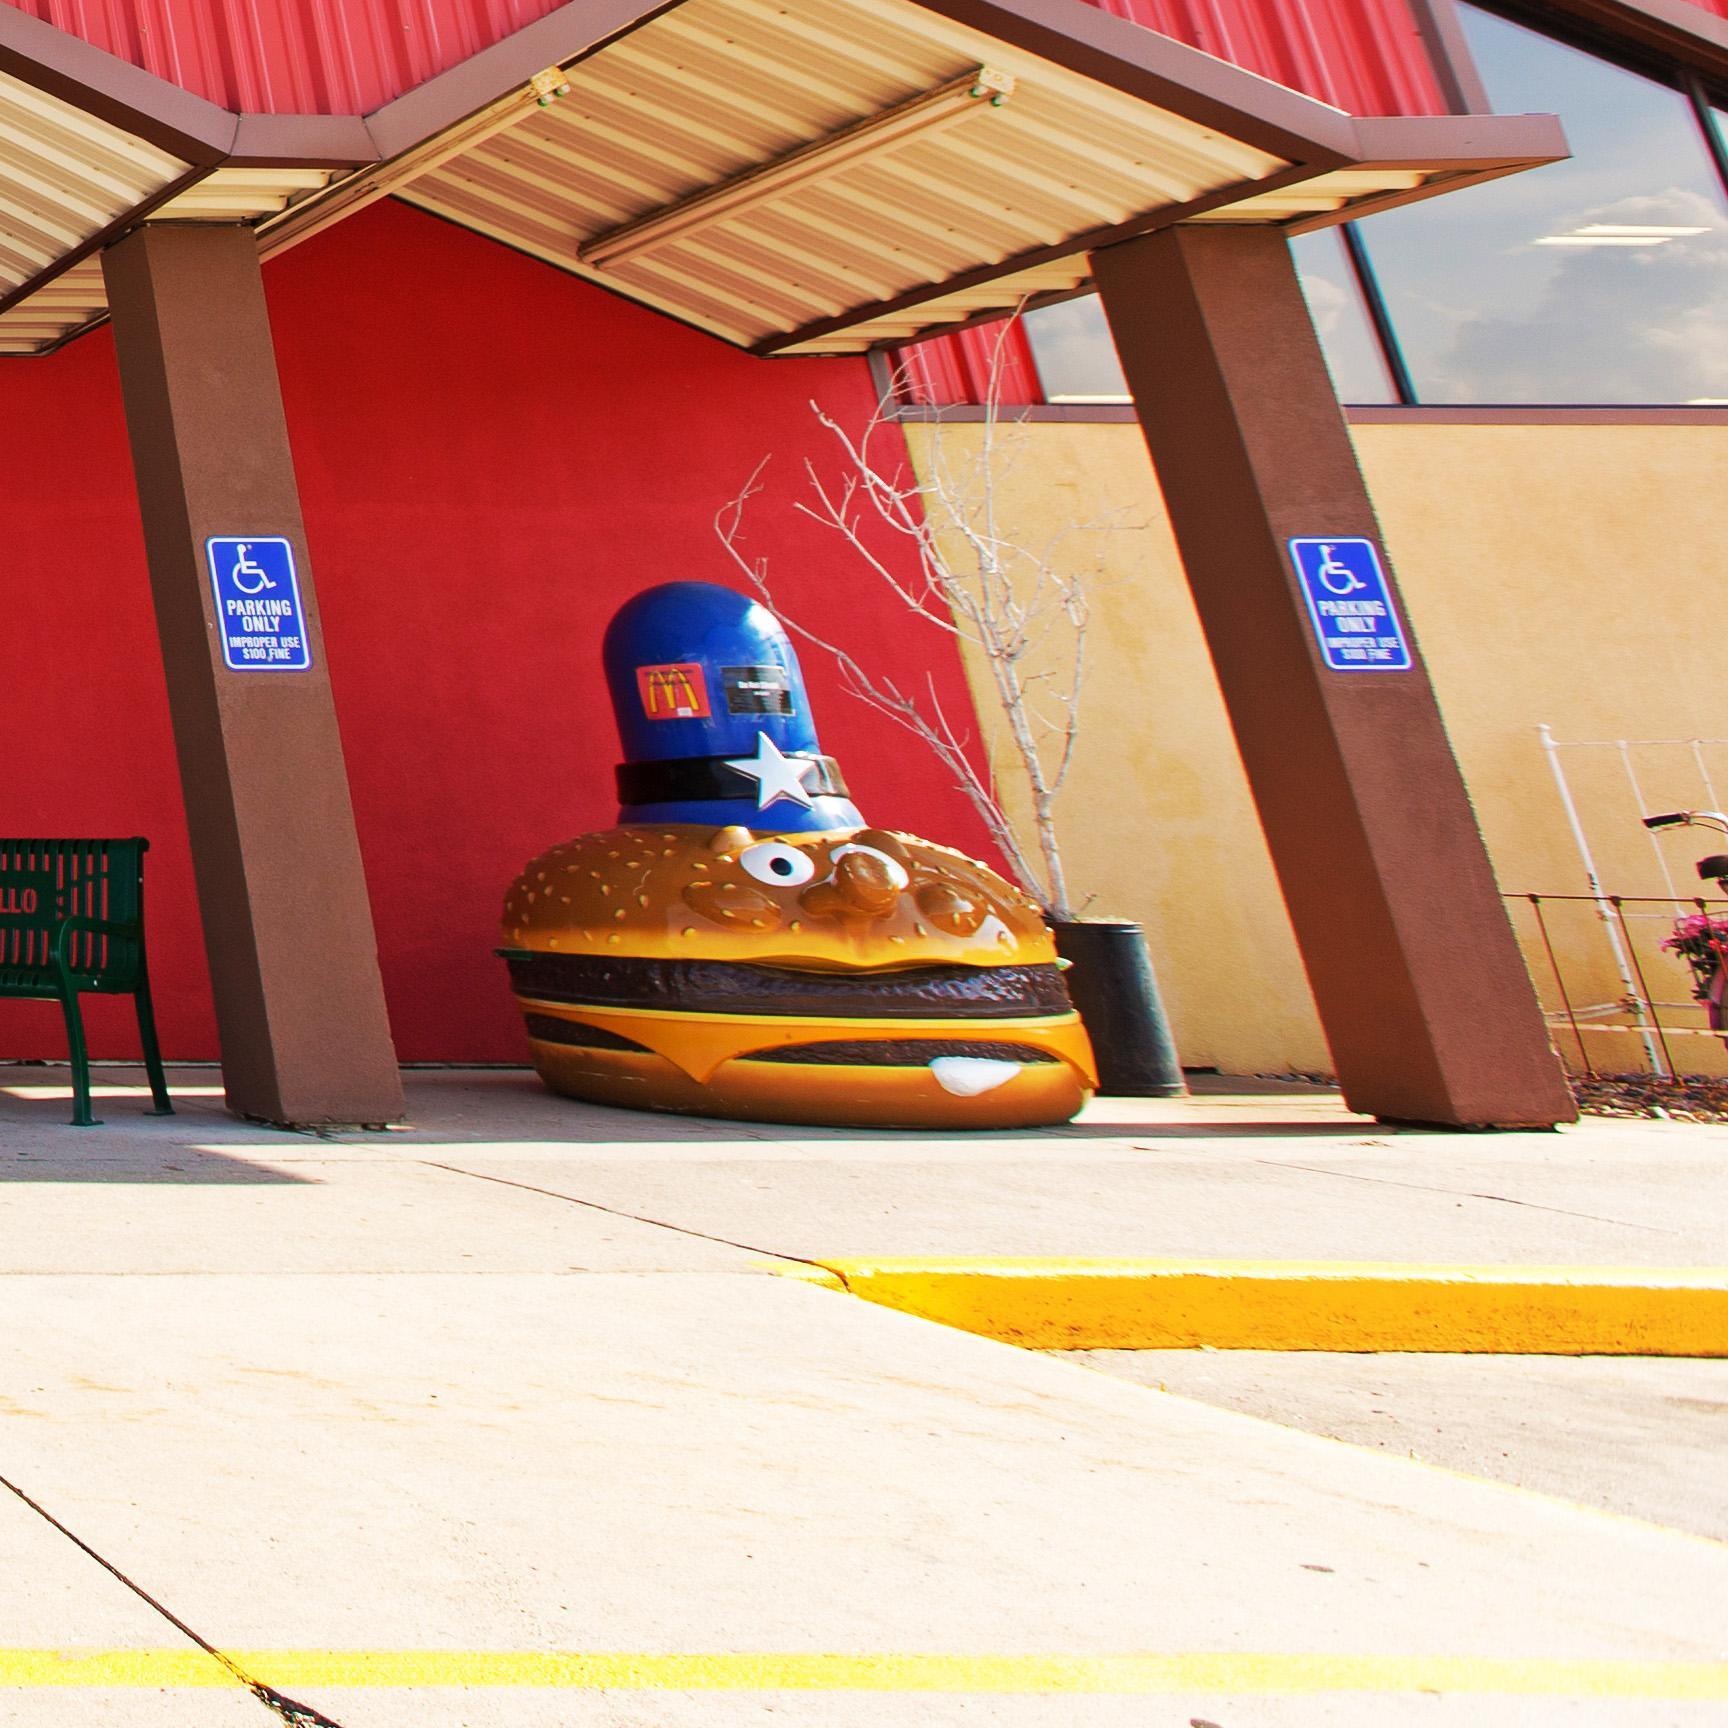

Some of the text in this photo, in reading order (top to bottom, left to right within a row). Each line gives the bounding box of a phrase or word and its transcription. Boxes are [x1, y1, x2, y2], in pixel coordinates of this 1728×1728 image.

[226, 600, 293, 616] PARKING
[242, 616, 281, 632] ONLY
[228, 636, 301, 648] IMPROPER USE
